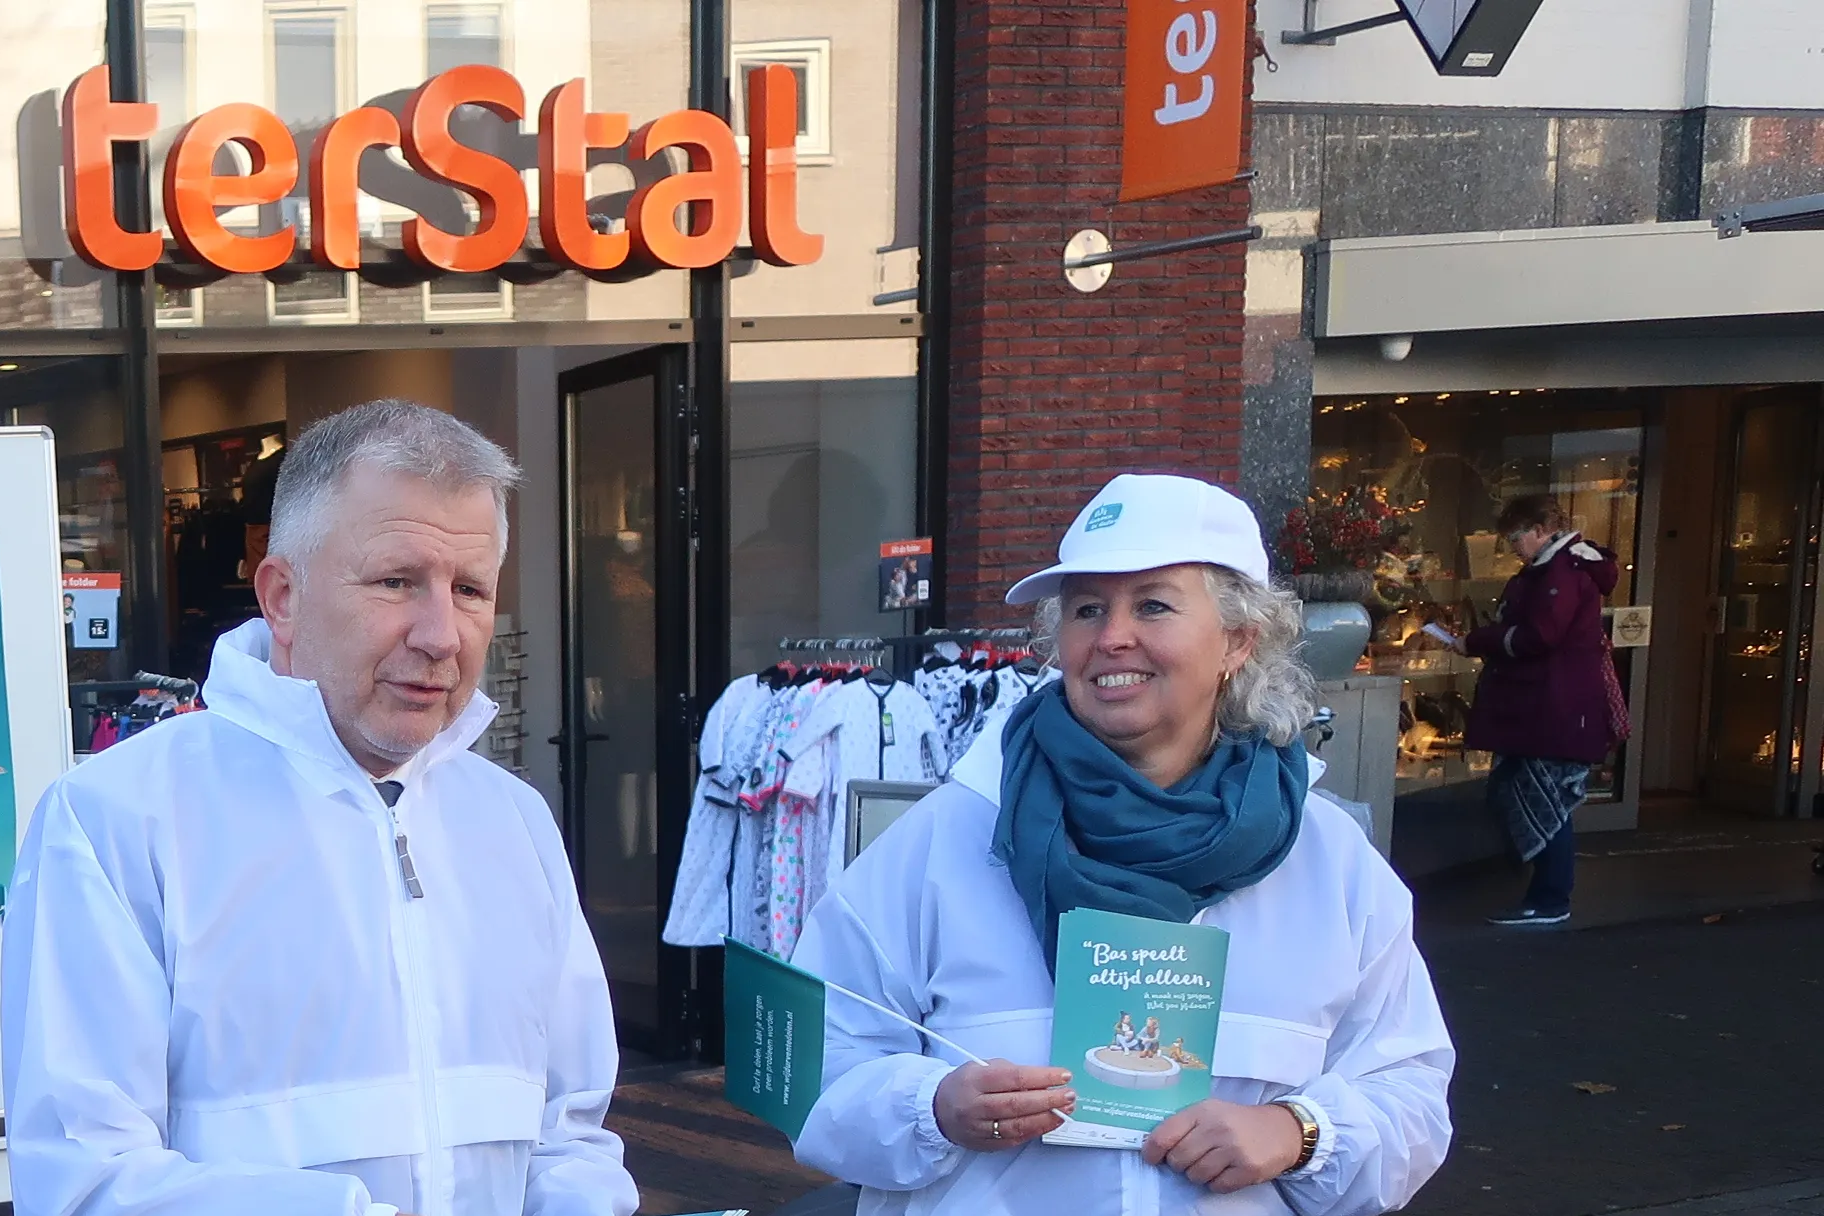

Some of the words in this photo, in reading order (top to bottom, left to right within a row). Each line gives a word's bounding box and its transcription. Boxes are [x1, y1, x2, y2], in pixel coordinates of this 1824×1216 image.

[62, 62, 824, 274] terStal
[1131, 945, 1188, 967] speelt
[1089, 968, 1142, 991] altijd
[1144, 969, 1211, 988] alleen,
[756, 994, 764, 1020] zorgen
[765, 1038, 774, 1074] probleem
[782, 1010, 794, 1105] www.wijdurventedelen.nl
